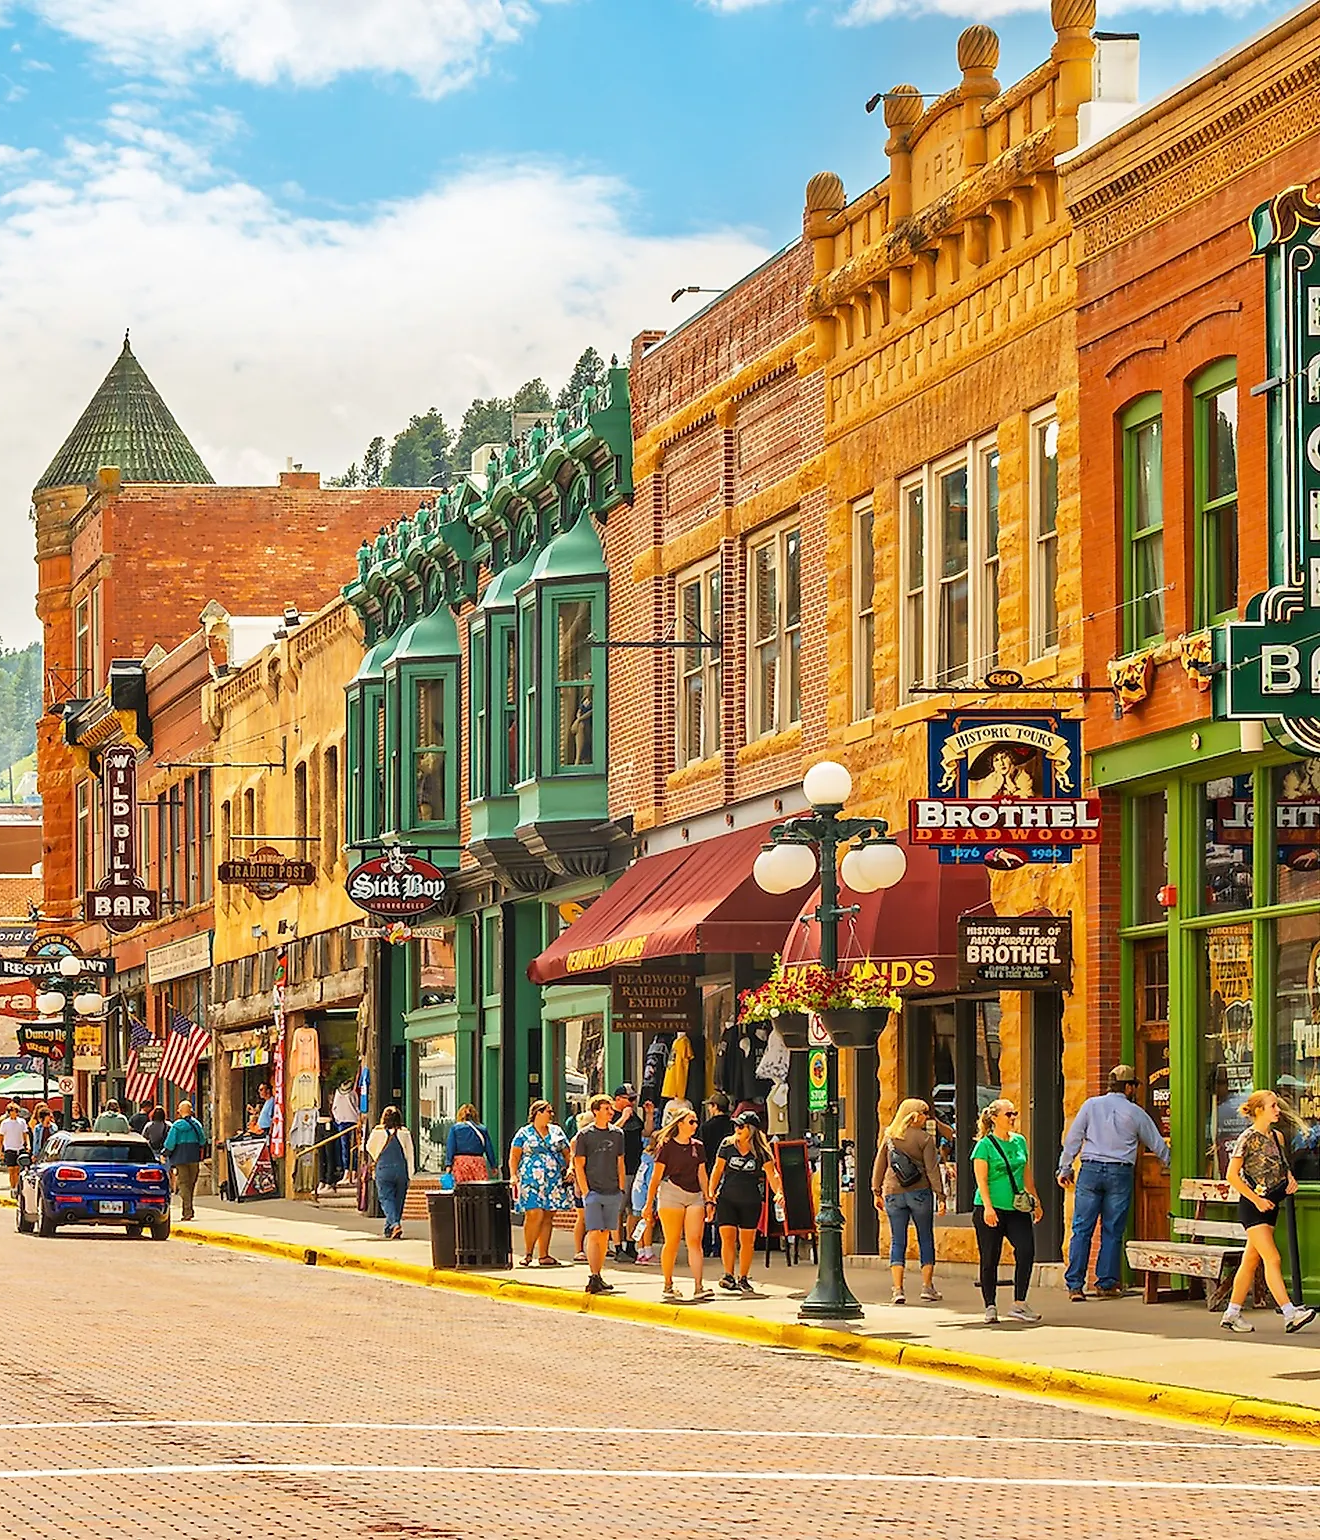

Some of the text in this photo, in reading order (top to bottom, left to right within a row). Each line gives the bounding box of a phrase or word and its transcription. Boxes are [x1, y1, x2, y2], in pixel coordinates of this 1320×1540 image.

[956, 726, 1053, 748] HISTORIC TOURS
[112, 754, 130, 886] WILD BILL
[916, 800, 1100, 828] BROTHEL
[916, 828, 1098, 841] DEADWOOD
[949, 846, 980, 858] 1876
[228, 864, 306, 879] TRADING POST
[350, 872, 447, 901] Sick Boy
[94, 896, 151, 917] BAR
[966, 926, 1061, 936] HISTORIC SITE OF
[1033, 936, 1057, 946] DOOR
[966, 945, 1062, 964] BROTHEL
[3, 959, 108, 976] RESTAUANT
[618, 974, 690, 985] DEADWOOD
[621, 986, 687, 997] RAILROAD
[628, 997, 678, 1008] EXHIBIT
[615, 1021, 691, 1030] BASEMENT LEVEL
[14, 1062, 24, 1071] a
[811, 1090, 826, 1100] STOP
